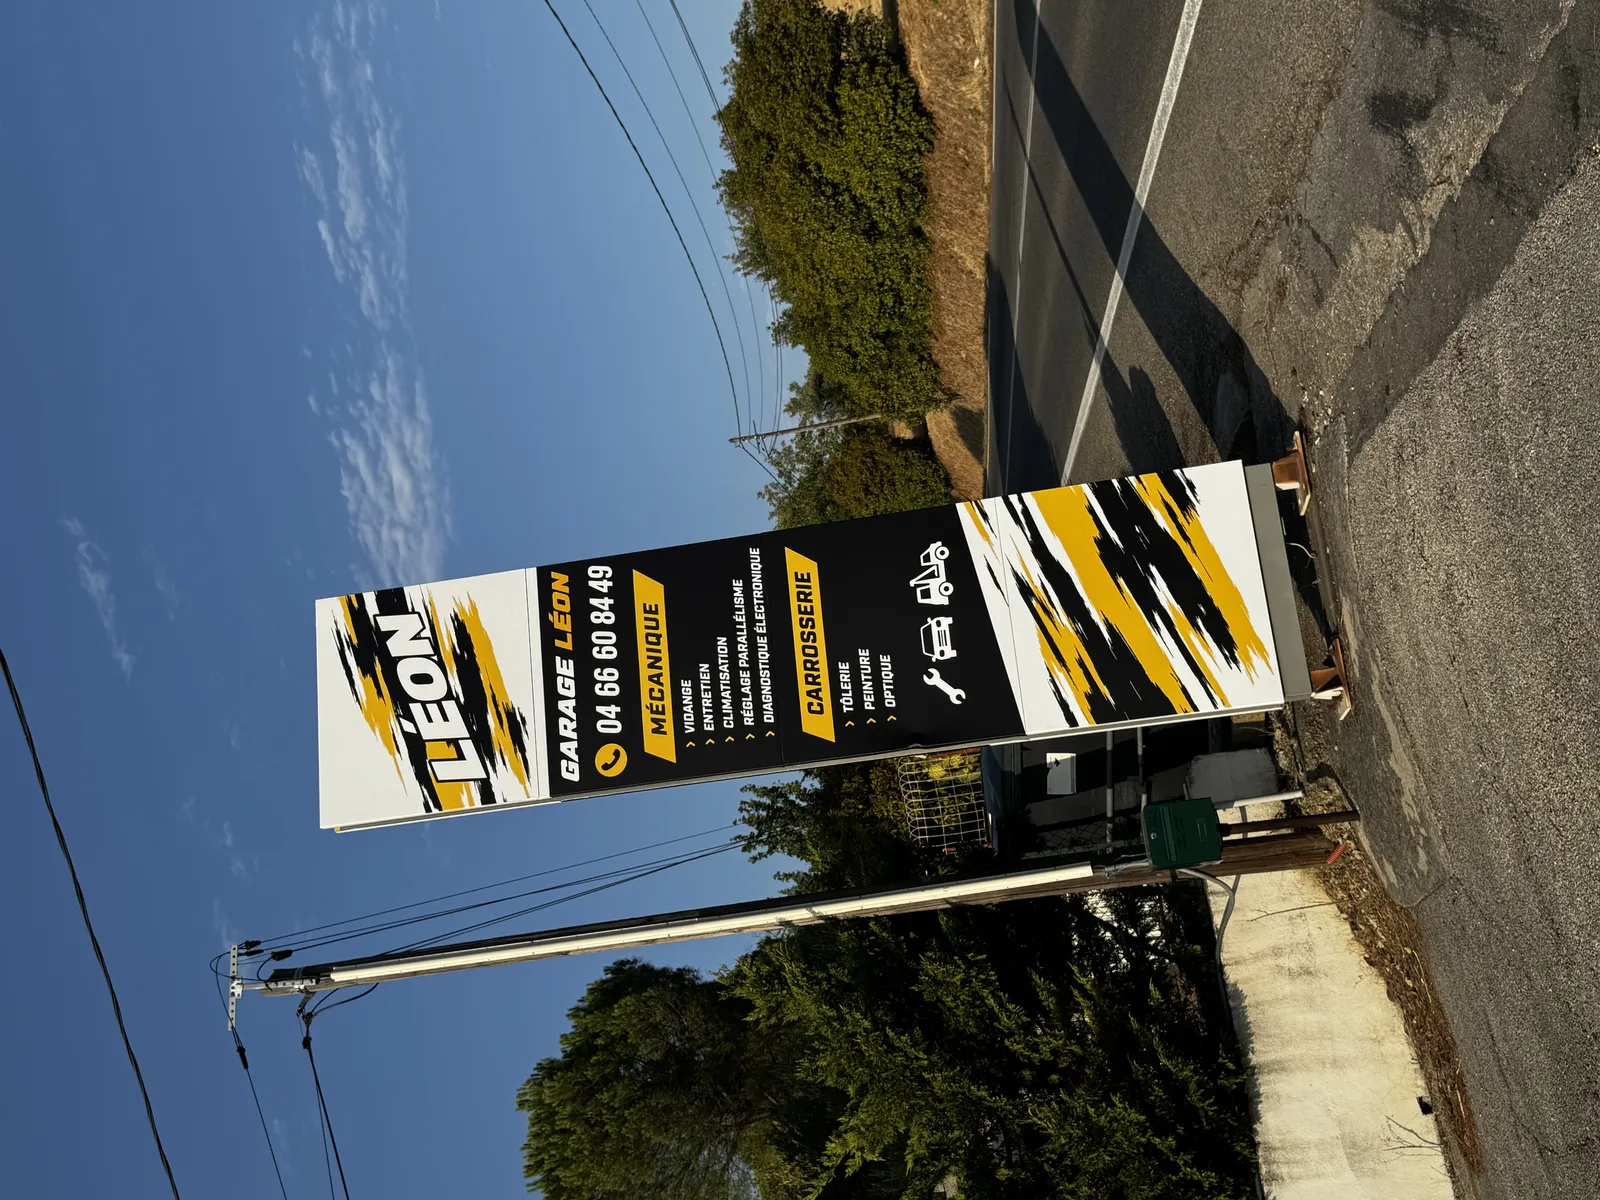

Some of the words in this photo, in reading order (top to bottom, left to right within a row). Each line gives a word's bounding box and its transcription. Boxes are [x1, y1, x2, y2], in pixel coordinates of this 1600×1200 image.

[548, 571, 574, 651] LÉON
[587, 565, 613, 593] 49
[589, 596, 616, 625] 84
[749, 547, 768, 634] ÉLECTRONIQUE
[591, 631, 618, 660] 60
[732, 578, 751, 669] PARALLÉLISME
[794, 571, 825, 716] CARROSSERIE
[374, 612, 489, 782] LÉON
[593, 668, 620, 697] 66
[642, 602, 668, 736] MÉCANIQUE
[699, 663, 715, 732] ENTRETIEN
[716, 636, 734, 729] CLIMATISATION
[739, 670, 755, 726] RÉGLAGE
[757, 635, 775, 724] DIAGNOSTIQUE
[838, 661, 855, 713] TÔLERIE
[858, 648, 876, 711] PEINTURE
[879, 653, 897, 708] OPTIQUE
[555, 656, 580, 782] GARAGE
[596, 704, 622, 733] 04
[681, 679, 695, 733] VIDANGE
